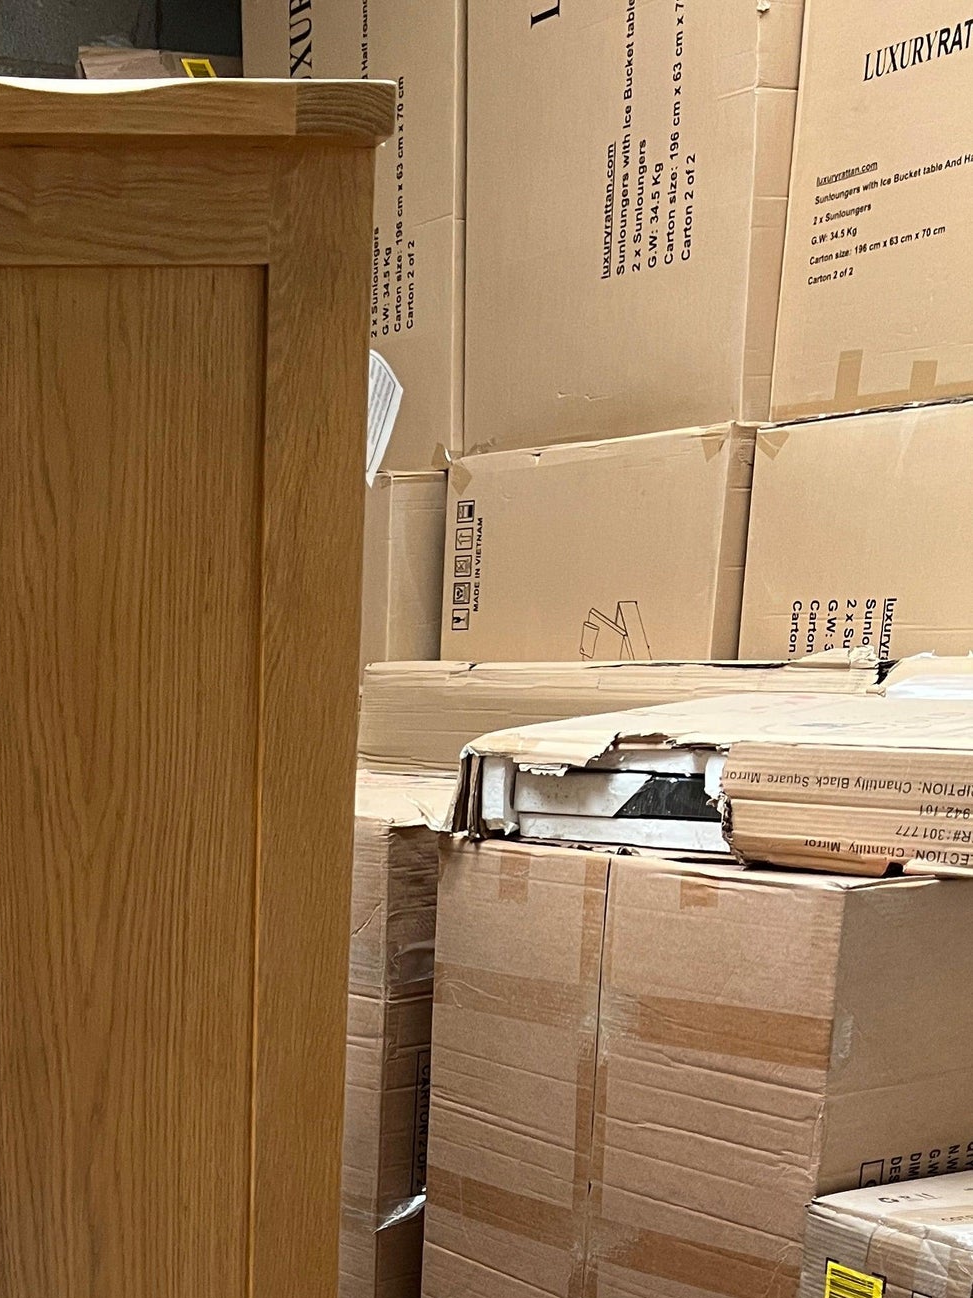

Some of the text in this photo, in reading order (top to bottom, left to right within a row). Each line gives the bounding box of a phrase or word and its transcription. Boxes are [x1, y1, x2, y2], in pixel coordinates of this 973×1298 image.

[675, 30, 684, 57] cm
[623, 41, 635, 100] Bucket
[672, 62, 682, 82] 63
[622, 105, 632, 129] Ice
[672, 101, 681, 127] cm
[622, 133, 631, 168] with
[669, 131, 680, 161] 196
[667, 166, 678, 205] size:
[815, 157, 963, 205] Sunloungers with Ice Bucket table And
[816, 161, 878, 187] luxuryrattan.com
[601, 142, 616, 280] luxuryrattan.com
[616, 172, 630, 276] Sunloungers
[632, 139, 647, 273] 2 Sunloungers
[647, 162, 664, 268] G.W: 34.5 Kg
[681, 153, 696, 261] Carton 2 of 2
[825, 203, 872, 223] Sunloungers
[664, 209, 676, 265] Carton
[809, 253, 834, 266] Carton
[854, 242, 867, 254] 196
[869, 240, 881, 250] cm
[889, 235, 899, 246] 63
[900, 233, 913, 243] cm
[921, 228, 931, 238] 70
[933, 225, 946, 235] cm
[829, 229, 846, 242] 34.5
[846, 226, 858, 238] Kg
[808, 267, 848, 286] Carton of
[394, 286, 402, 333] Carton
[407, 283, 415, 329] Carton
[475, 517, 483, 565] VIETNAM
[474, 568, 481, 578] IN
[825, 599, 838, 638] G.W:
[845, 613, 854, 622] x
[847, 599, 857, 608] 2
[788, 600, 803, 653] Carton
[806, 600, 820, 653] Carton
[725, 770, 912, 793] Chantilly Black Square Mirror
[804, 839, 905, 858] Chantilly Mirror
